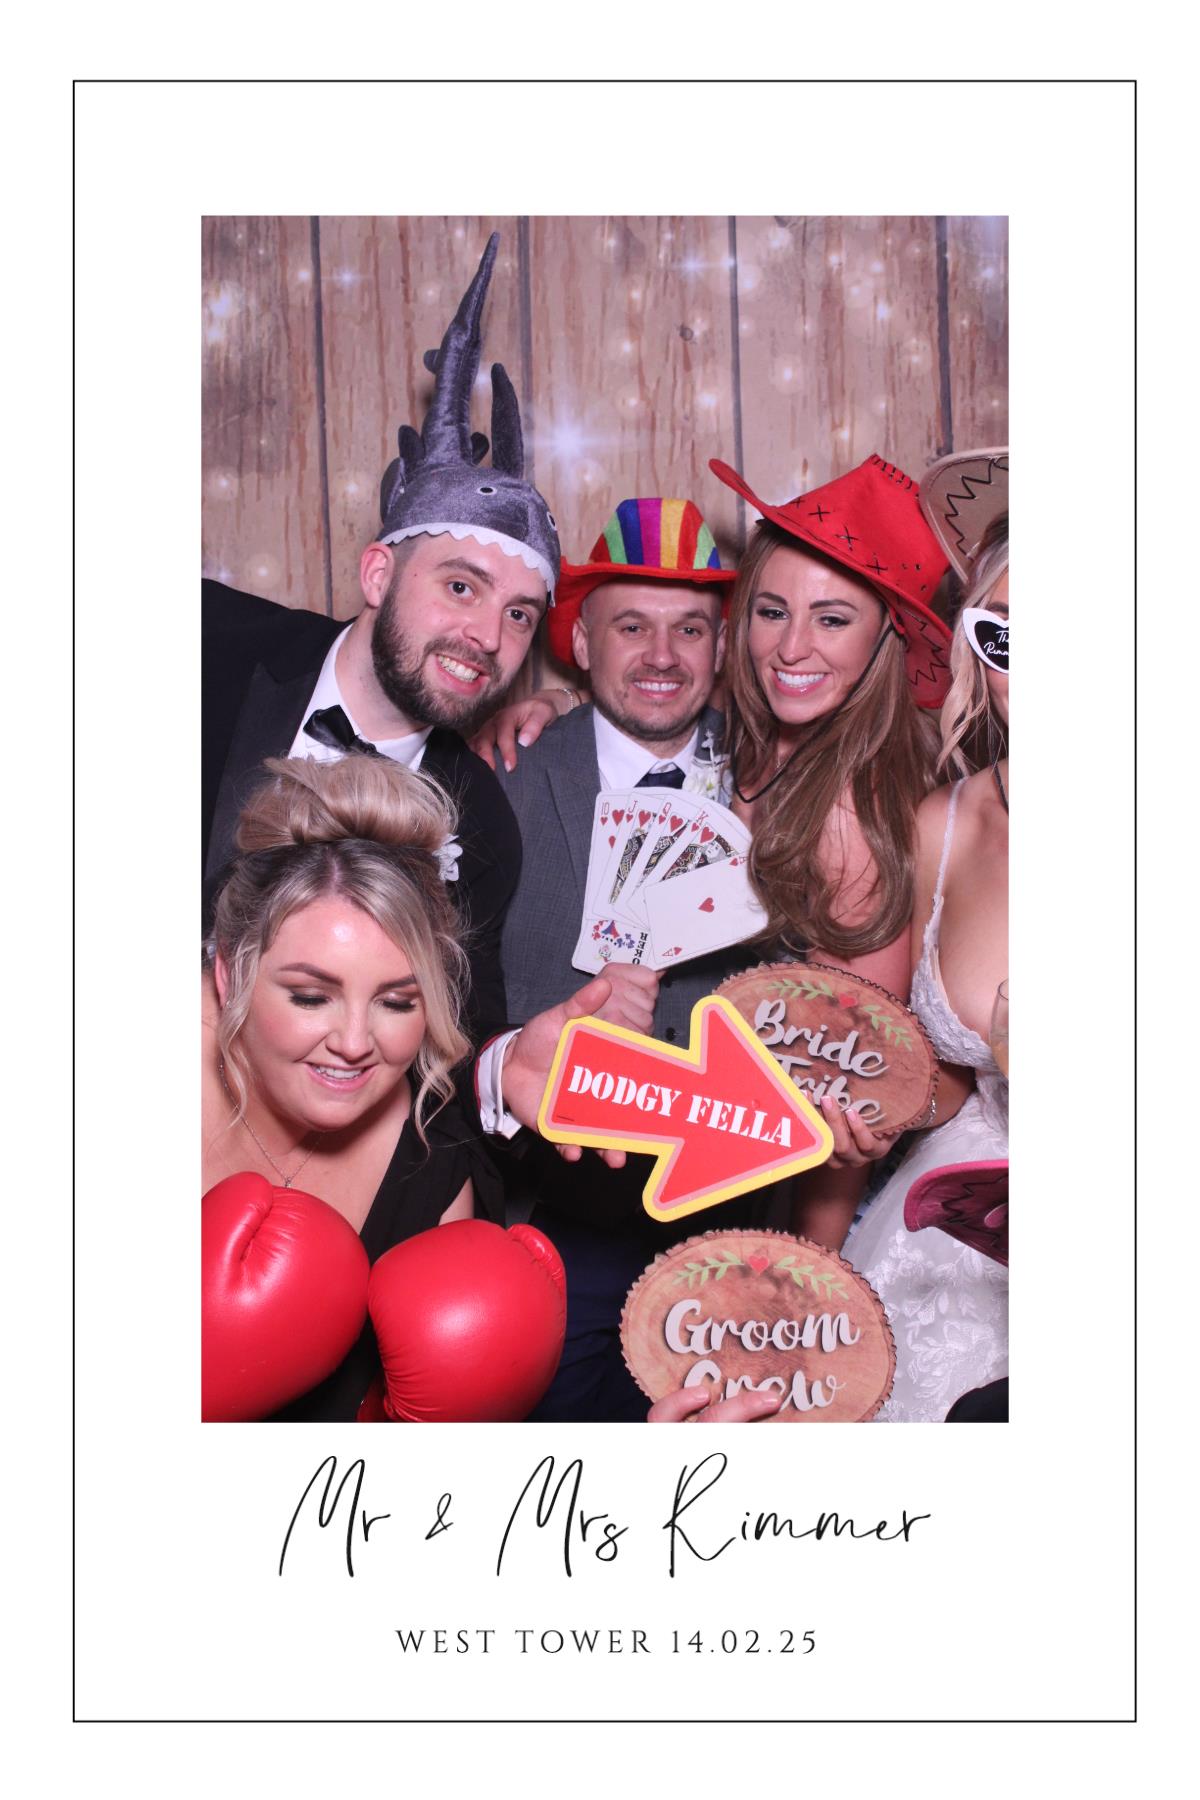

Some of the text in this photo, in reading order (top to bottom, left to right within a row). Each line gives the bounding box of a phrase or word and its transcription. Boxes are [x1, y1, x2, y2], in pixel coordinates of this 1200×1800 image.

[996, 630, 1009, 643] Th
[601, 802, 609, 815] 10
[628, 800, 638, 813] J
[662, 802, 672, 816] Q
[697, 811, 709, 824] K
[631, 932, 648, 965] OKER
[662, 948, 673, 957] A
[754, 998, 890, 1077] Bride
[567, 1065, 792, 1148] DODGY FELLA
[665, 1299, 860, 1355] Groom
